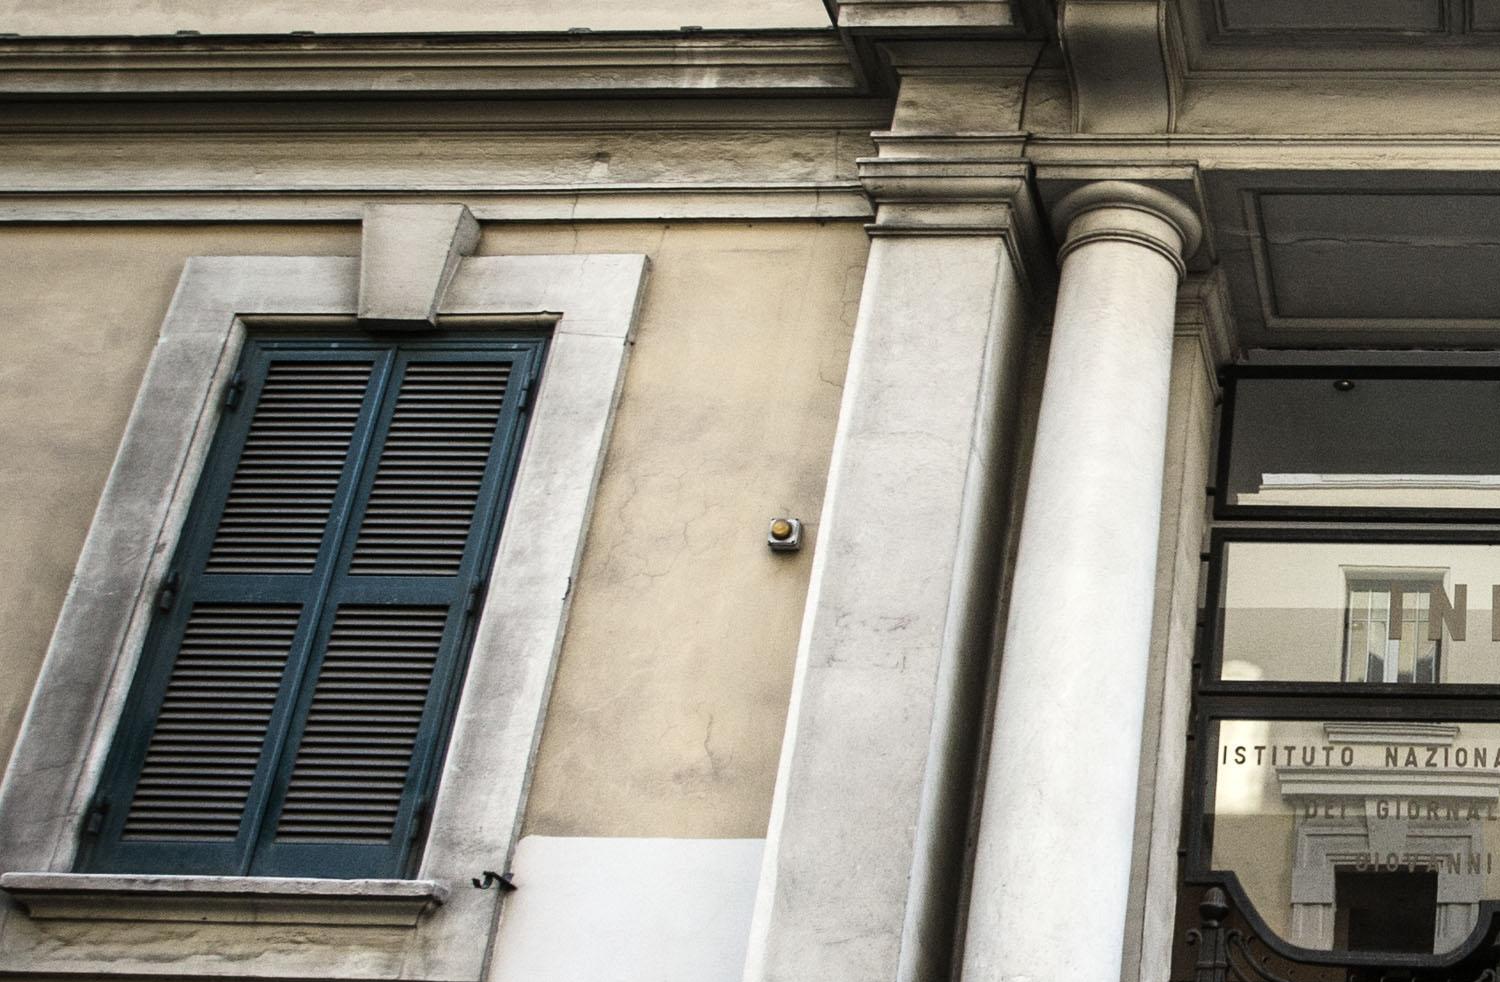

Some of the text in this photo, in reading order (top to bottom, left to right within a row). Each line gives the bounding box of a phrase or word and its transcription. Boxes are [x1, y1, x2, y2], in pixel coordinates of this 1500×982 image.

[1222, 745, 1354, 767] ISTITUTO
[1304, 799, 1347, 820] DEI
[1355, 851, 1493, 875] GIOVANNI
